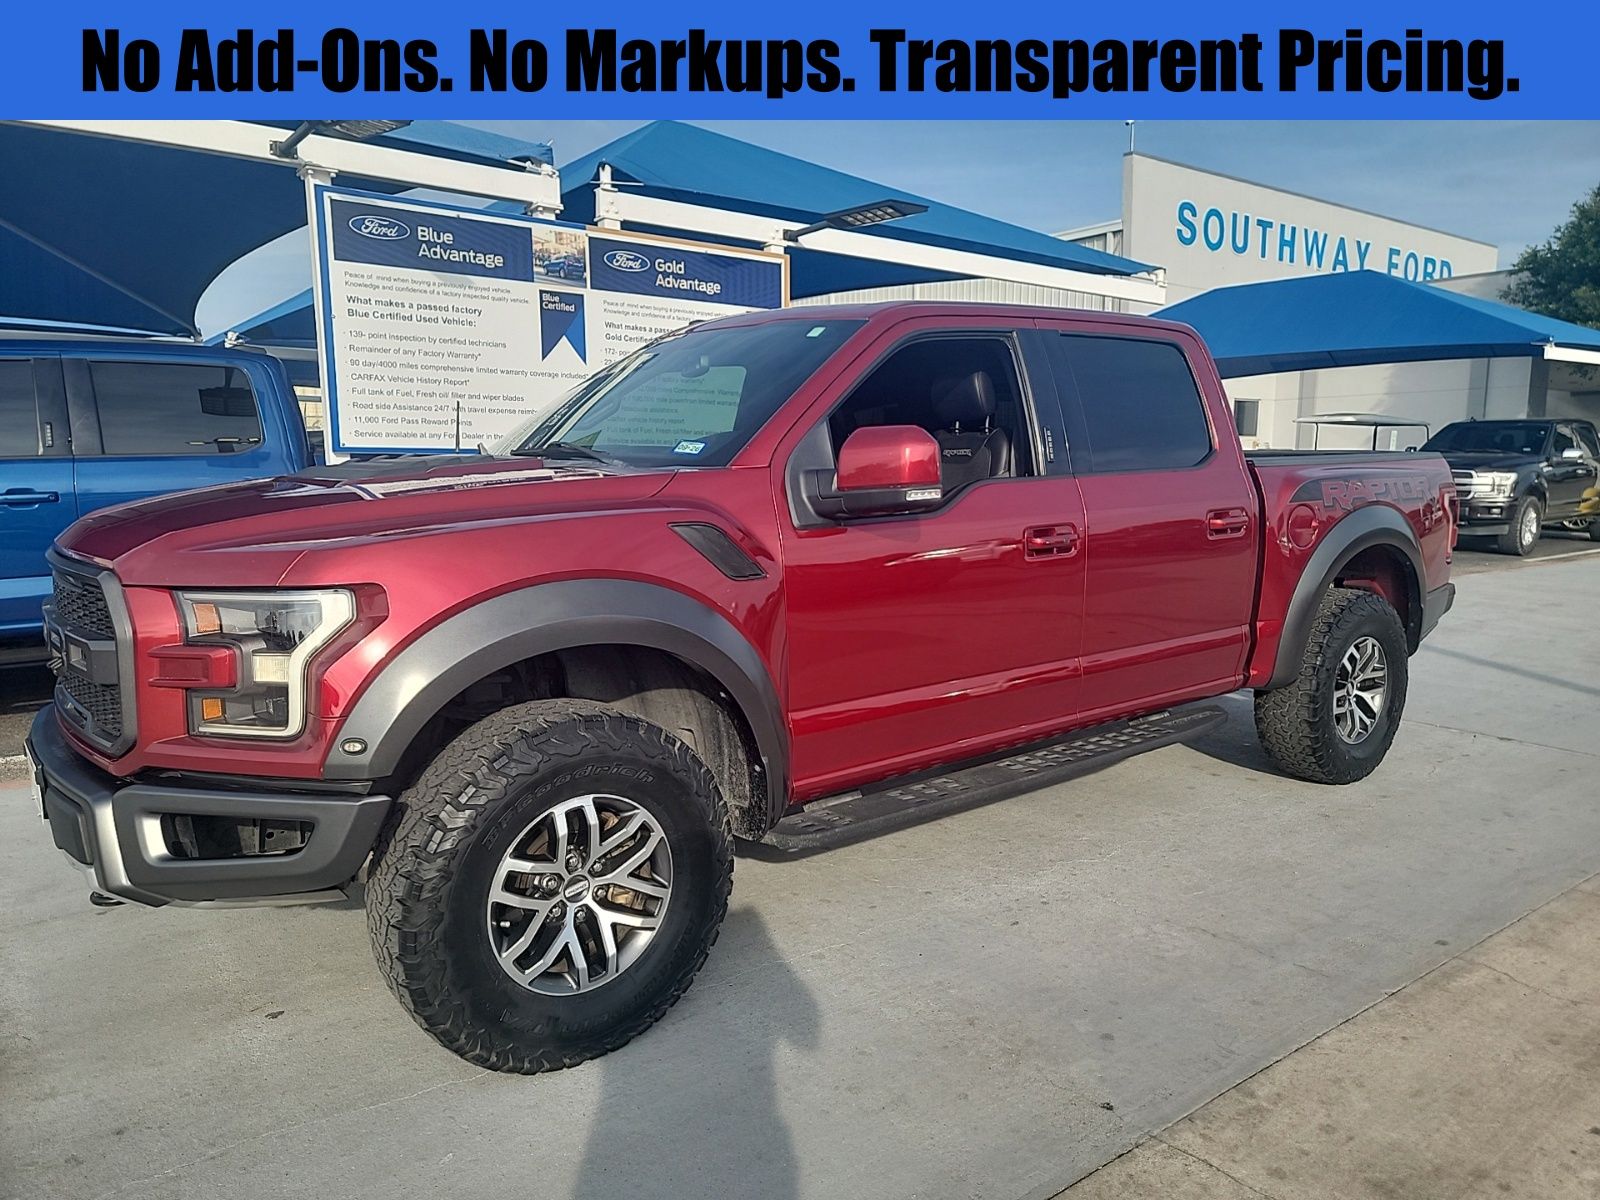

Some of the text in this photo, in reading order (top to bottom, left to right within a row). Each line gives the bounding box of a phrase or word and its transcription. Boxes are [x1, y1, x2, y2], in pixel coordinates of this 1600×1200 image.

[361, 217, 399, 238] Ford
[417, 226, 454, 244] Blue
[1176, 201, 1453, 282] SOUTHWAY FORD
[418, 243, 505, 268] Advantage
[612, 252, 642, 269] Ford
[655, 258, 685, 275] Gold
[344, 271, 365, 280] Peace
[376, 275, 392, 283] mind
[411, 278, 431, 287] buying
[655, 274, 721, 295] Advantage
[345, 280, 380, 290] Knowledge
[382, 283, 394, 291] and
[394, 285, 428, 295] confidence
[441, 289, 462, 299] factory
[542, 293, 560, 302] Blue
[346, 295, 372, 306] What
[375, 298, 405, 308] makes
[416, 302, 449, 313] passed
[451, 305, 482, 317] factory
[542, 301, 575, 312] Certified
[347, 308, 477, 328] Blue Certified Used Vehicle:
[604, 321, 623, 330] What
[624, 323, 647, 333] makes
[368, 331, 387, 340] point
[388, 332, 427, 344] inspection
[428, 336, 437, 345] by
[438, 337, 467, 346] certified
[468, 338, 507, 348] technicians
[605, 332, 622, 341] Gold
[349, 344, 391, 354] Remainder
[393, 347, 401, 355] of
[402, 349, 416, 358] any
[418, 348, 445, 359] Factory
[350, 358, 360, 367] 90
[362, 359, 398, 369] day/4000
[399, 362, 419, 370] miles
[420, 363, 475, 374] comprehensive
[476, 366, 498, 375] limited
[500, 369, 528, 378] warranty
[529, 371, 559, 379] coverage
[350, 372, 386, 382] CARFAX
[387, 375, 415, 384] Vehicle
[416, 376, 442, 387] History
[351, 387, 366, 395] Full
[367, 387, 384, 396] tank
[416, 390, 438, 398] Fresh
[450, 391, 466, 399] filter
[483, 394, 501, 402] wiper
[502, 394, 525, 402] blades
[352, 401, 374, 410] Road
[375, 402, 391, 410] side
[392, 403, 433, 411] Assistance
[434, 404, 450, 413] 24/7
[467, 406, 487, 414] travel
[488, 407, 517, 415] expense
[354, 416, 473, 427] 11,000 Ford Pass Reward Pints
[354, 429, 383, 438] Service
[384, 430, 418, 439] available
[419, 431, 427, 439] at
[428, 432, 441, 441] any
[443, 431, 460, 440] For
[461, 432, 485, 440] Dealer
[1321, 476, 1433, 512] RAPTOR
